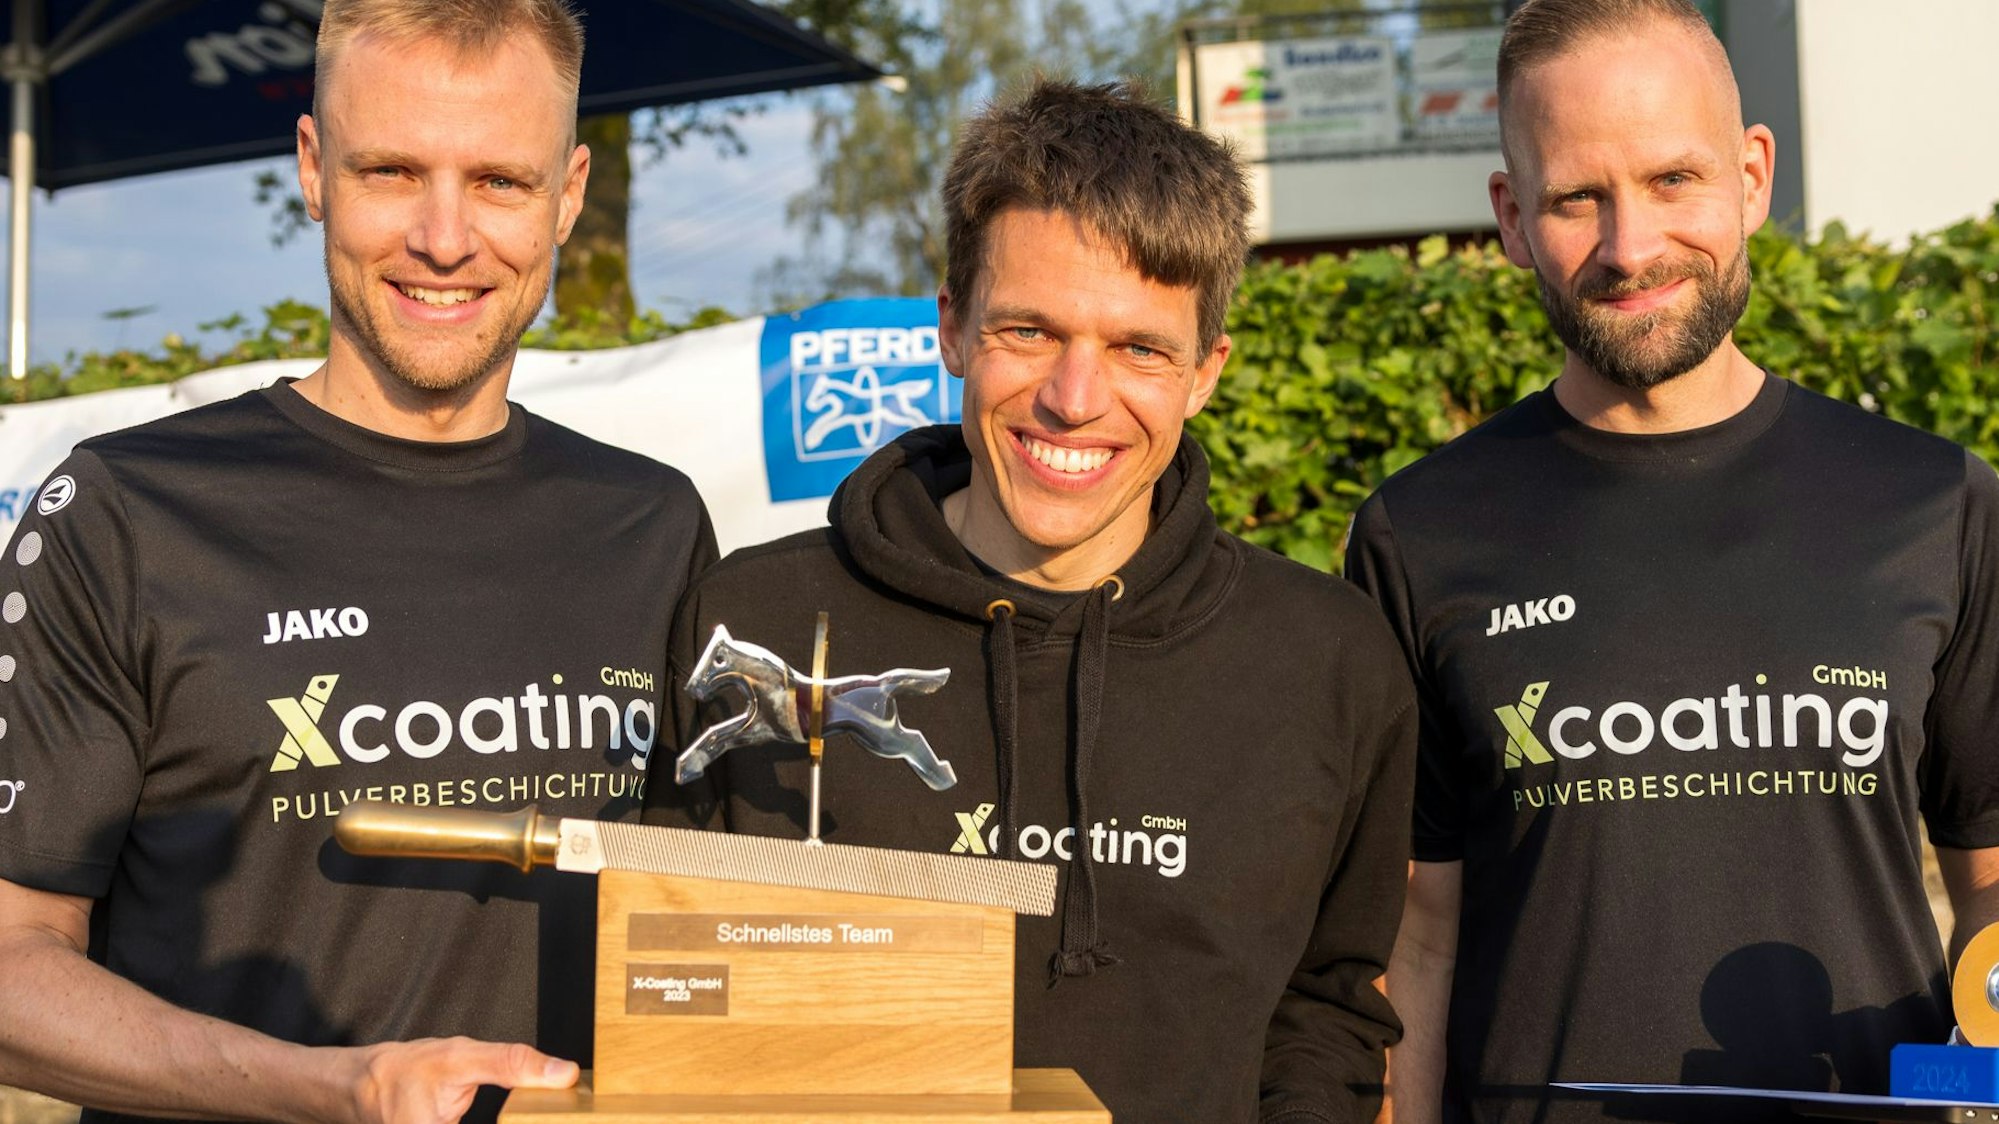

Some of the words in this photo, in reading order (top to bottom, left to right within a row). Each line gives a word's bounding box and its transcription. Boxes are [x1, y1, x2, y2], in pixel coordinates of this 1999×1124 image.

[790, 326, 941, 371] PFERD
[263, 606, 369, 644] JAKO
[1486, 594, 1576, 637] JAKO
[600, 666, 654, 693] GmbH
[1812, 664, 1887, 690] GmbH
[1513, 770, 1879, 811] PULVERBESCHICHTUNG
[1141, 814, 1187, 831] GmbH
[716, 922, 833, 943] Schnellstes
[838, 923, 893, 943] Team
[633, 977, 686, 991] X-Coating
[688, 978, 722, 990] GmbH
[663, 989, 691, 1001] 2023
[1912, 1062, 1970, 1095] 2024
